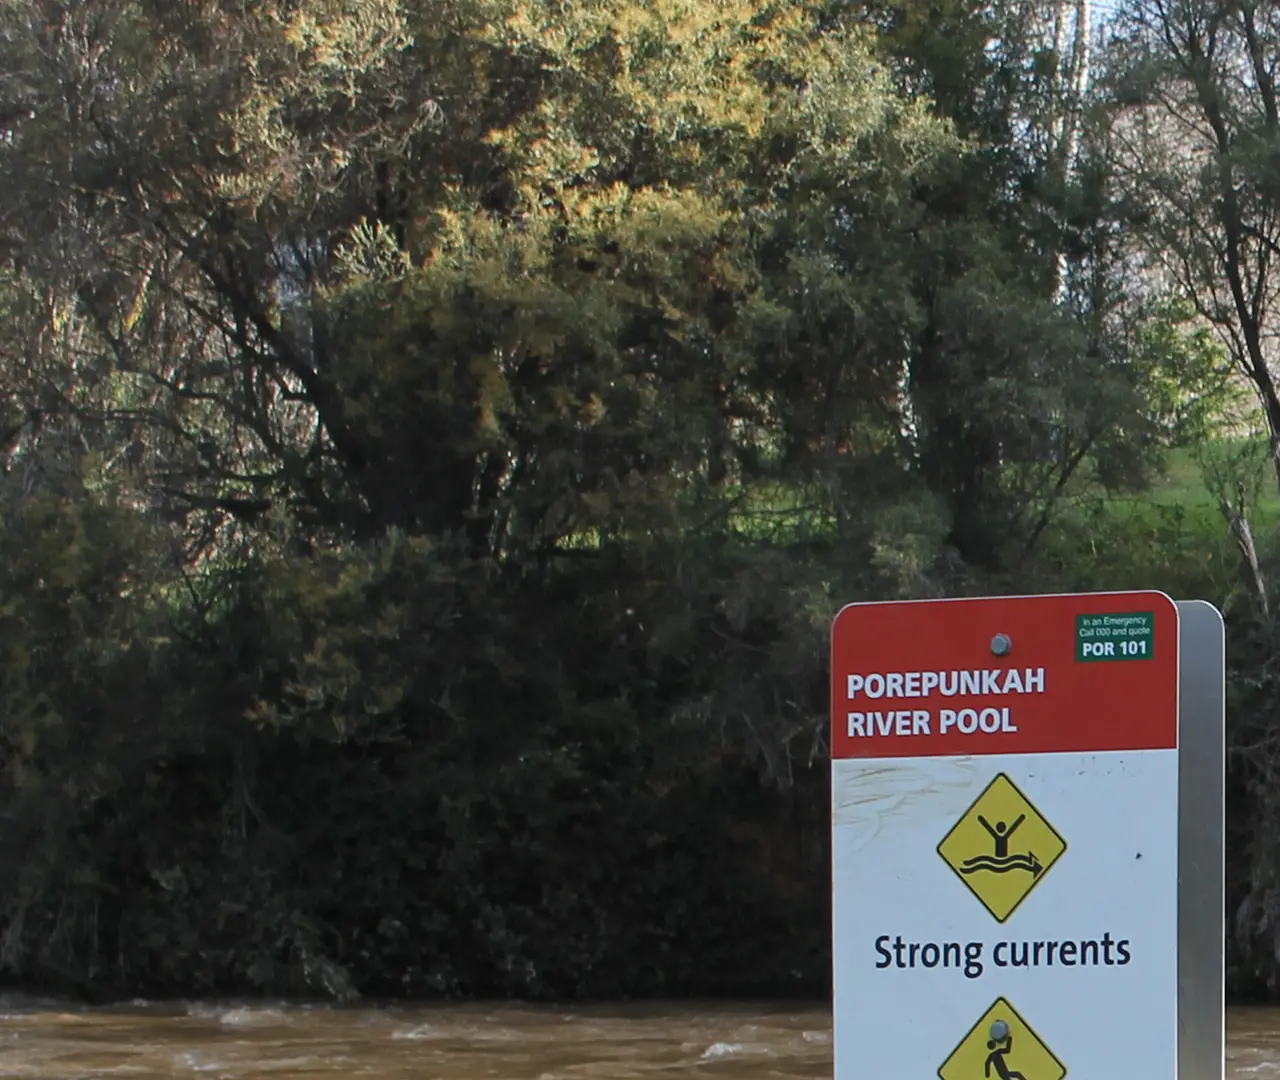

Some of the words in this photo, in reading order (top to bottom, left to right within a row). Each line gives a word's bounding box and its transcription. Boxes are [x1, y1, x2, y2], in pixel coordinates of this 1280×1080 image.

[1079, 628, 1094, 637] Call
[1096, 627, 1111, 636] 000
[1112, 627, 1127, 636] and
[1128, 627, 1151, 636] quote
[1092, 618, 1102, 626] an
[1103, 616, 1147, 627] Emergency
[1082, 641, 1115, 657] POR
[1119, 640, 1146, 656] 101
[847, 667, 1046, 699] POREPUNKAH
[847, 710, 931, 737] RIVER
[939, 708, 1018, 735] POOL
[874, 934, 984, 979] Strong
[992, 932, 1131, 967] currents
